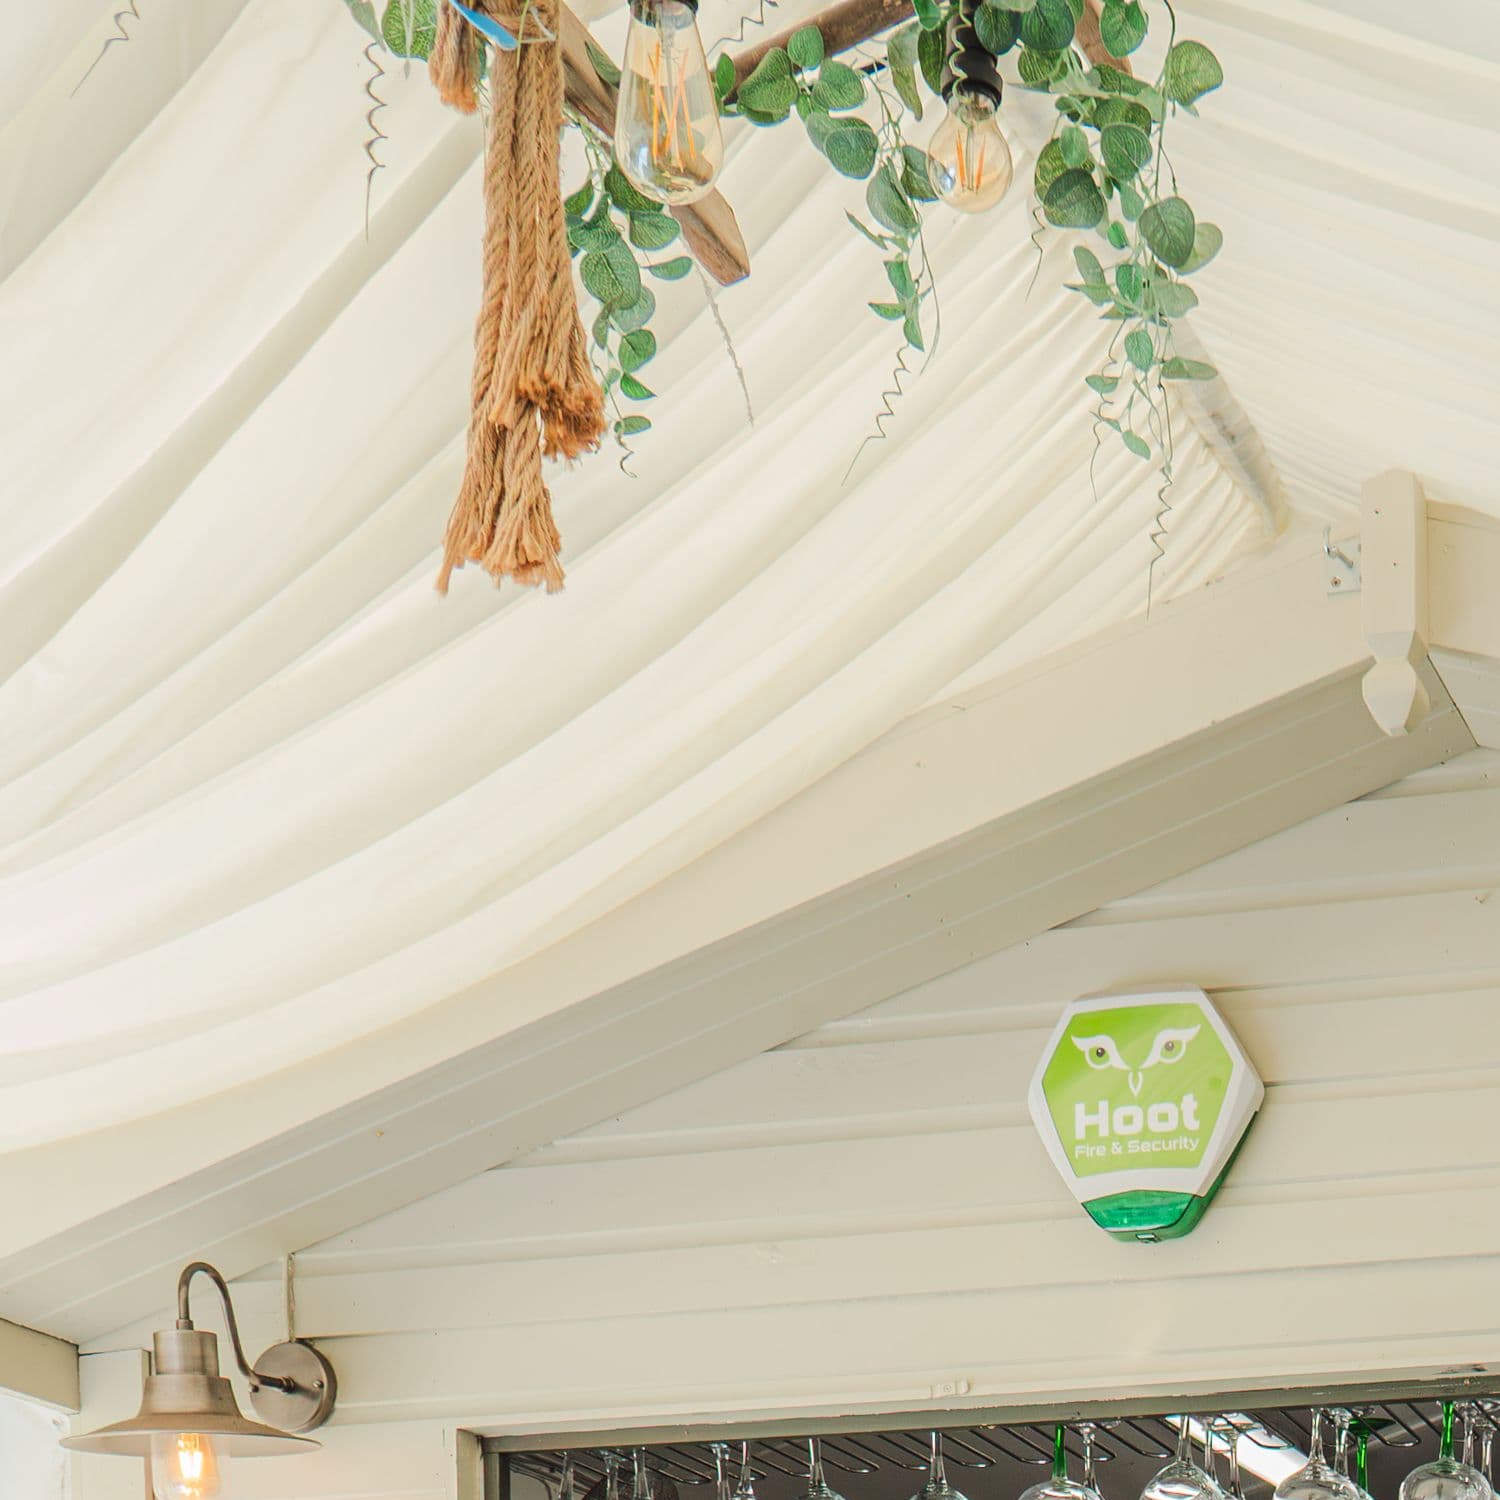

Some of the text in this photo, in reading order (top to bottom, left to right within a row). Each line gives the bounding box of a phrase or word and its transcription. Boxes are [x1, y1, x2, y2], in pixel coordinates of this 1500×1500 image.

[1074, 1093, 1200, 1139] Hoot
[1075, 1137, 1199, 1159] Fire & Security
